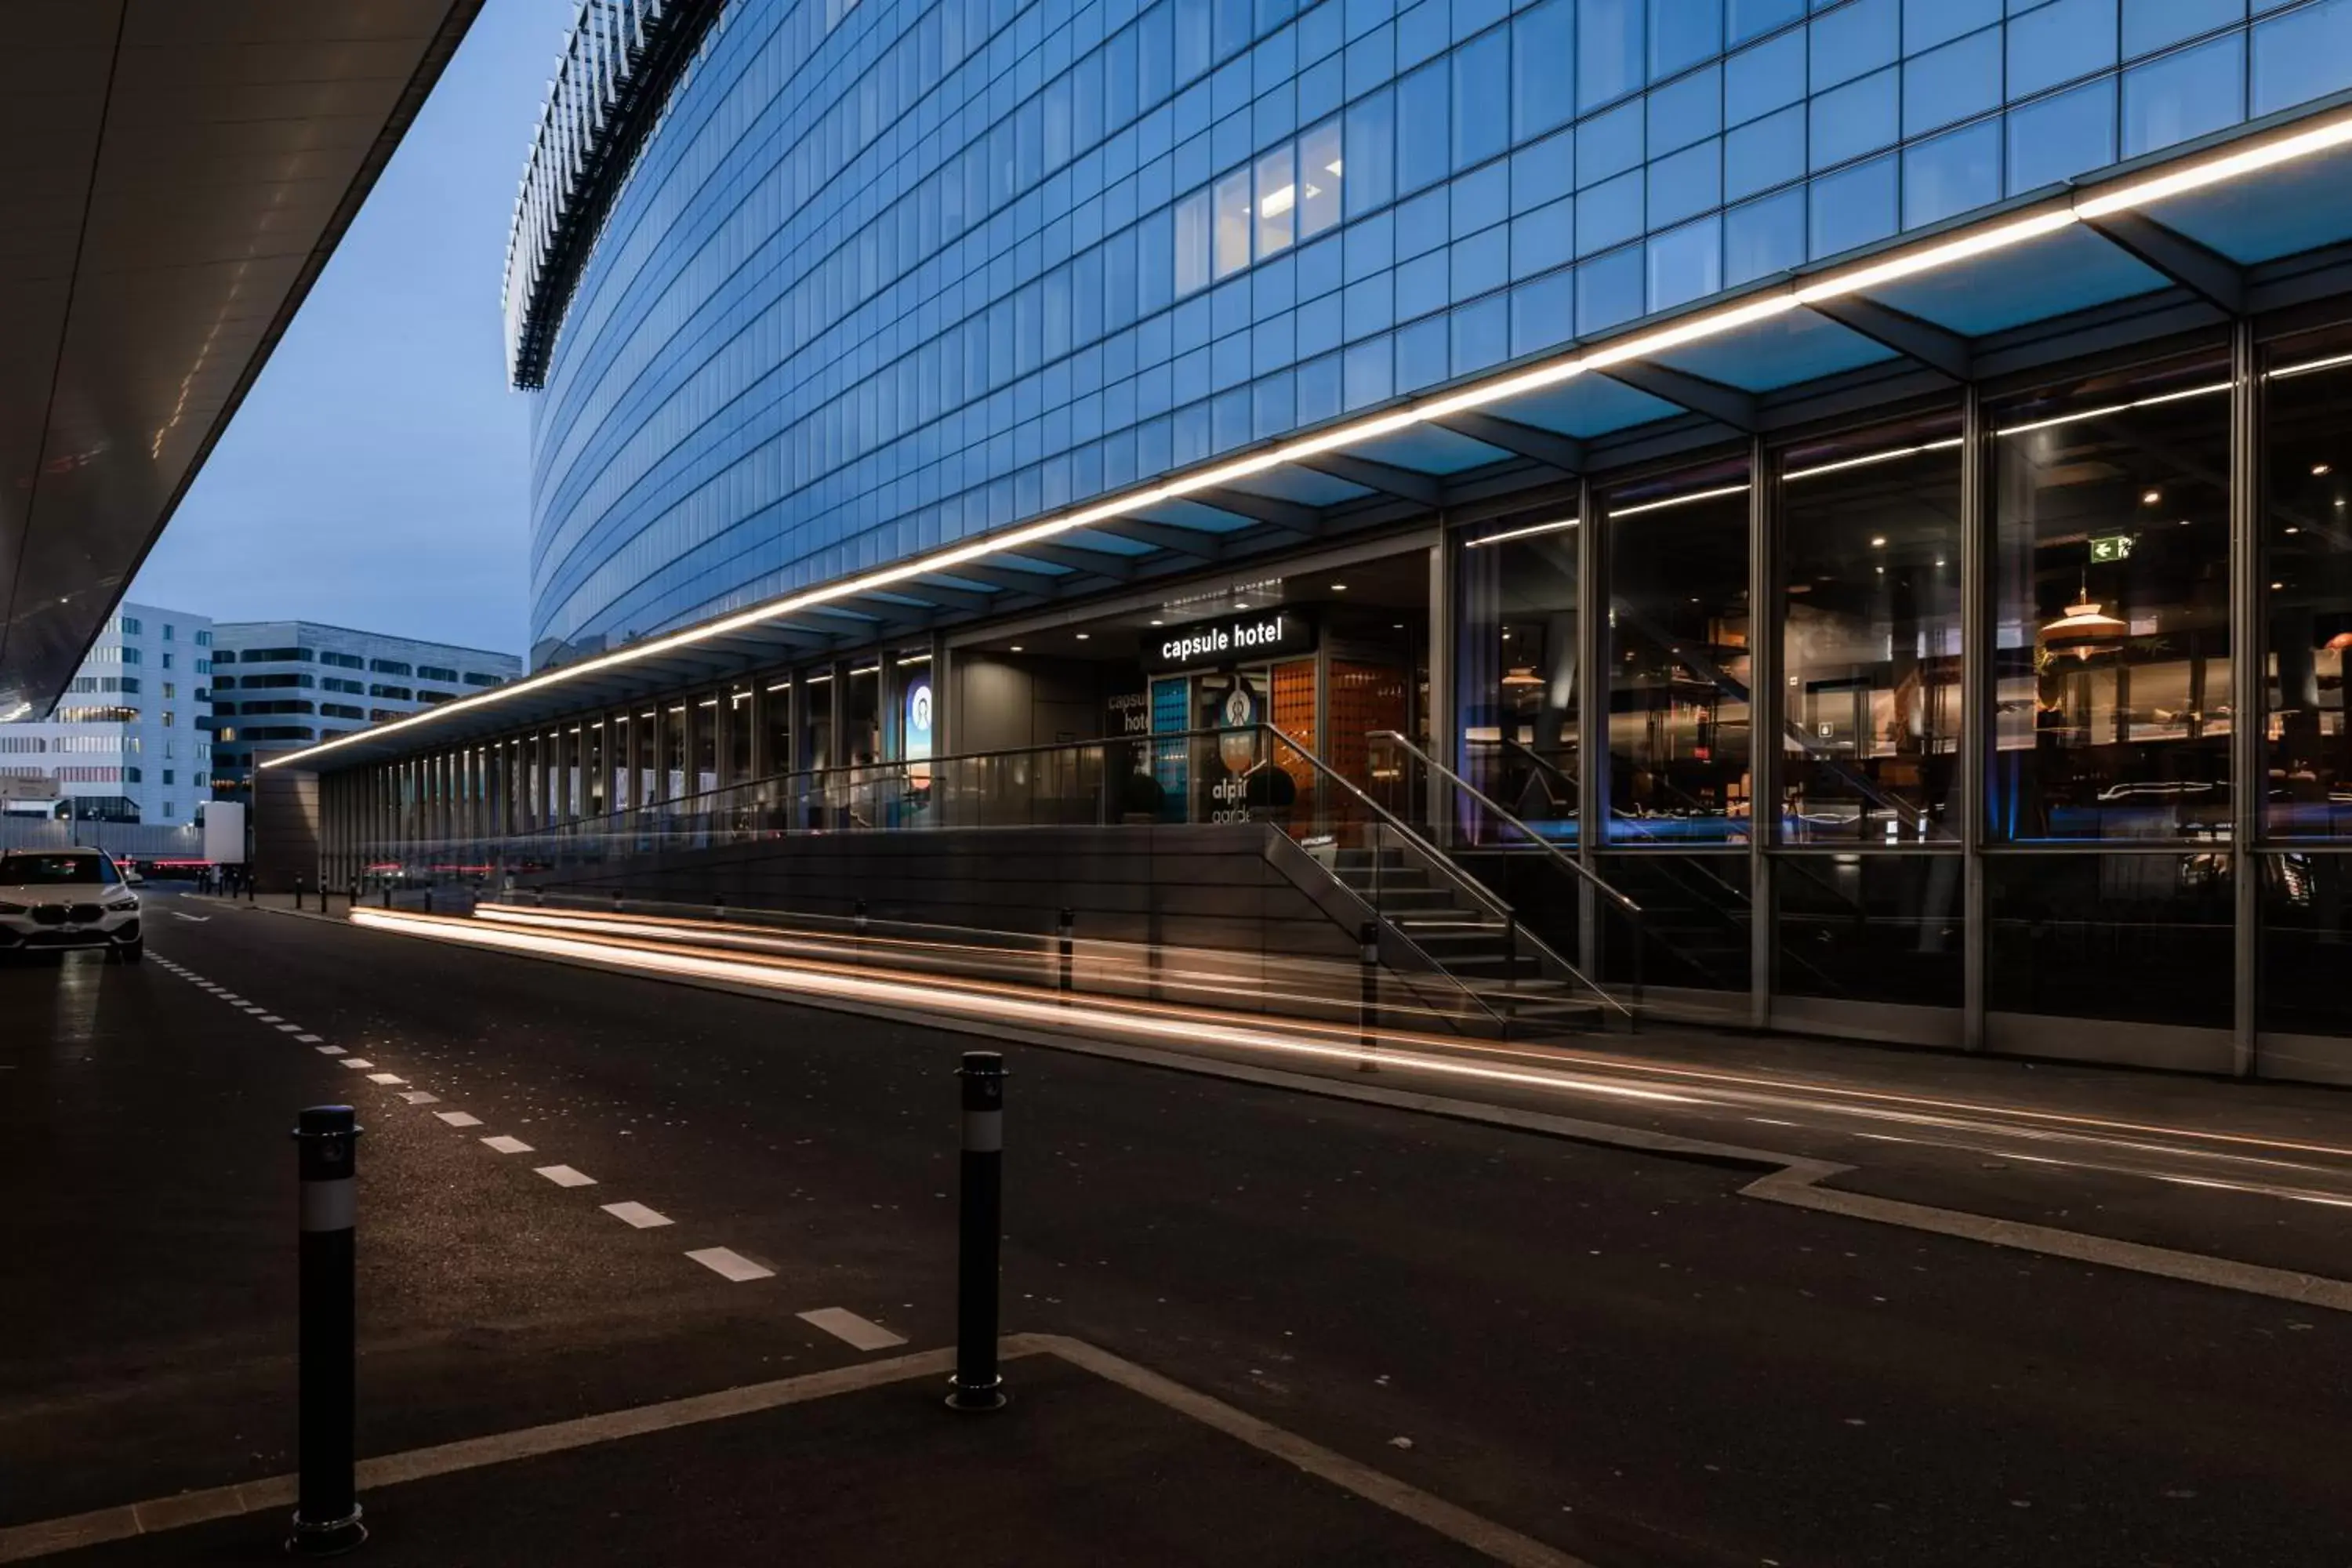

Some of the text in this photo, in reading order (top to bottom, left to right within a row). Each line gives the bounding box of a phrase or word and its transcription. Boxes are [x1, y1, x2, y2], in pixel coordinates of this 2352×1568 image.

[1163, 616, 1282, 661] capsule hotel
[1109, 695, 1145, 713] capsu
